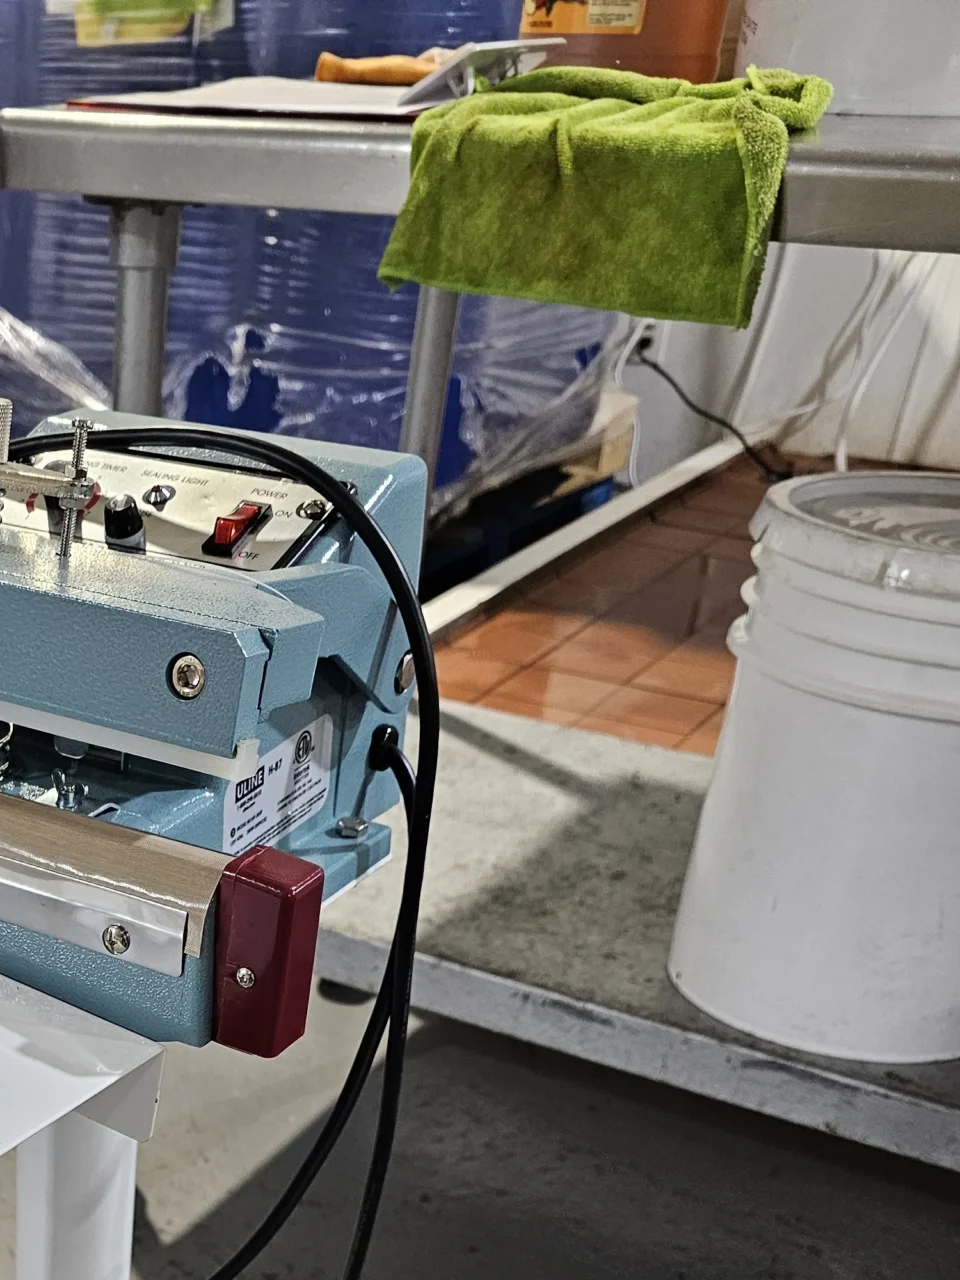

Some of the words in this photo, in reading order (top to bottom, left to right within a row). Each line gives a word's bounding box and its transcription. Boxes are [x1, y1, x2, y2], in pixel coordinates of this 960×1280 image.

[141, 469, 179, 483] SEALING
[181, 476, 210, 487] LIGHT
[251, 487, 288, 500] POWER
[274, 509, 293, 518] ON
[238, 551, 260, 560] OFF
[237, 769, 263, 799] ULINE
[268, 758, 282, 776] H-87
